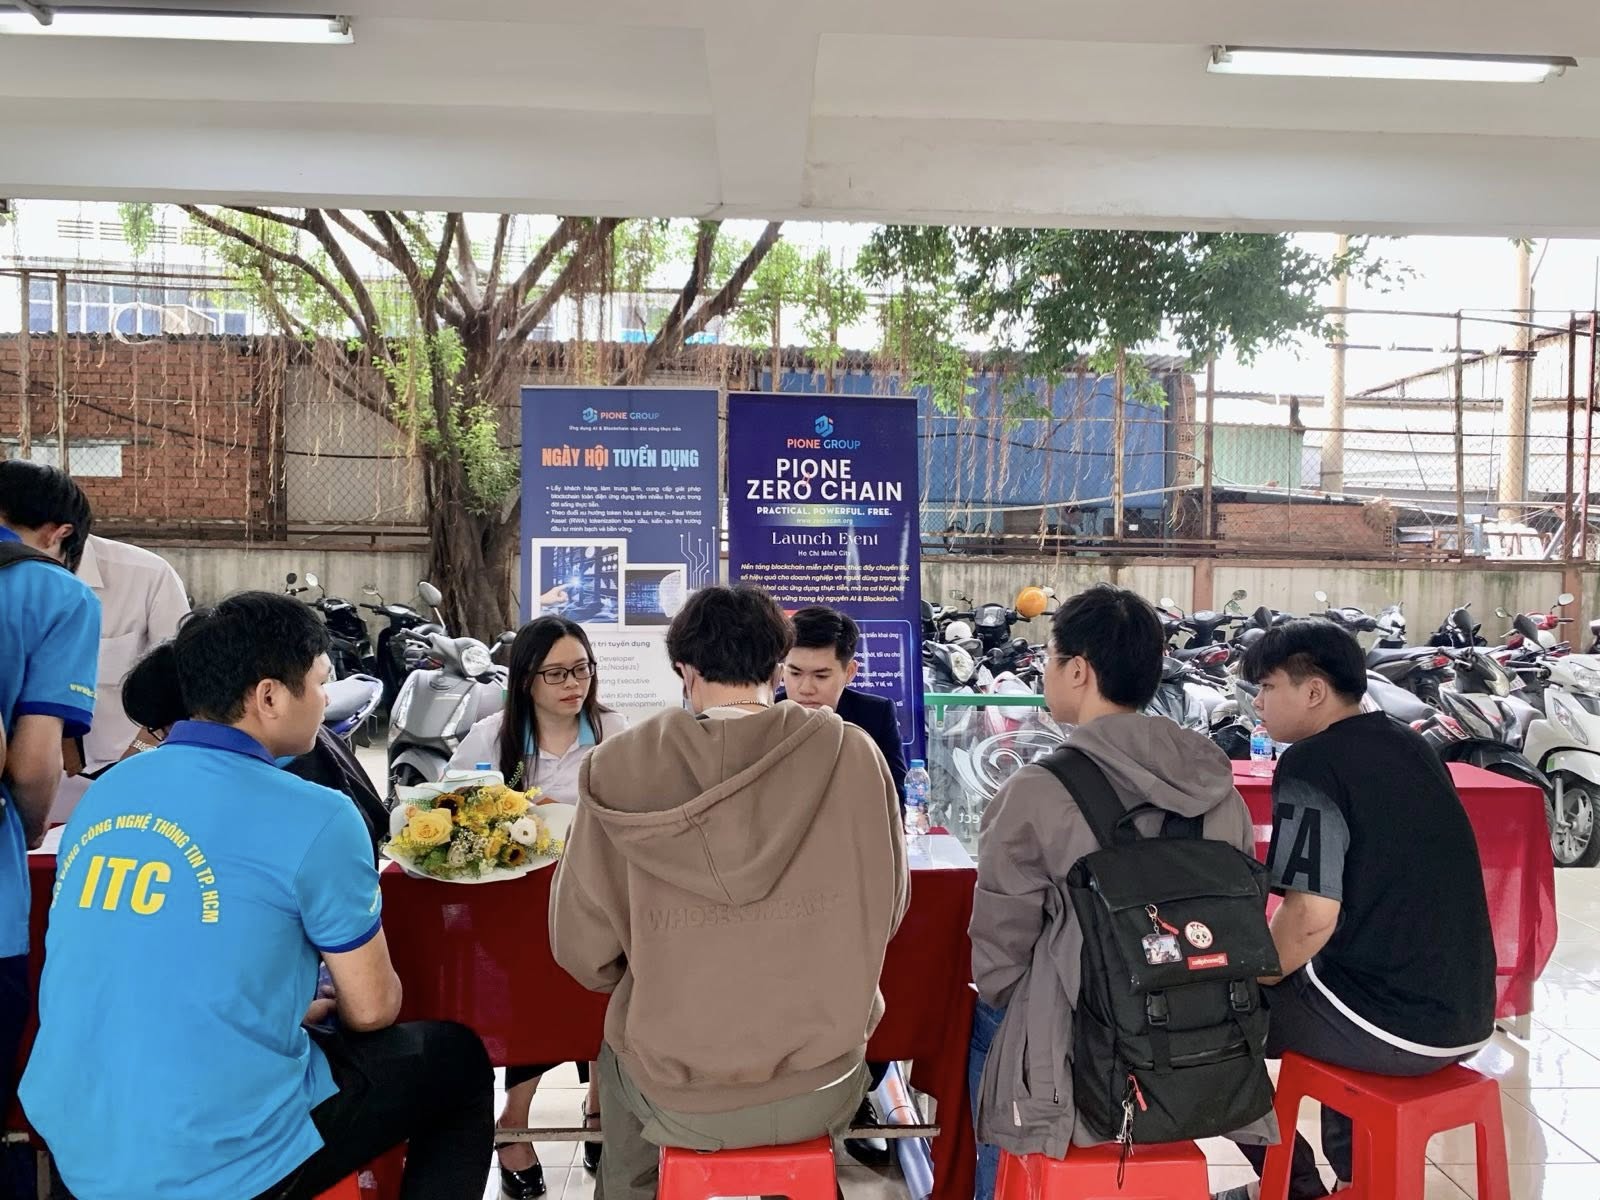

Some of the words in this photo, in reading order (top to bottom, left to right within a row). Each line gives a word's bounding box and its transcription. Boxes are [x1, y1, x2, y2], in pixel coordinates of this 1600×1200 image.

[600, 412, 628, 420] PIONE
[629, 412, 660, 420] GROUP
[787, 438, 821, 449] PIONE
[823, 439, 861, 450] GROUP
[542, 444, 580, 468] NGÀY
[584, 444, 609, 471] HỘI
[612, 443, 657, 468] TUYỂN
[661, 449, 699, 472] DỤNG
[776, 458, 852, 480] PIONE
[746, 479, 812, 500] ZERO
[820, 480, 903, 502] CHAIN
[756, 506, 811, 515] PRACTICAL.
[813, 507, 865, 516] POWERFUL.
[867, 507, 893, 516] FREE.
[772, 532, 832, 545] Launch
[839, 532, 878, 546] Event
[80, 818, 113, 847] CÔNG
[115, 813, 153, 833] NGHỆ
[152, 817, 191, 849] THÔNG
[183, 843, 207, 869] TIN
[201, 889, 220, 924] HCM
[78, 855, 172, 916] ITC
